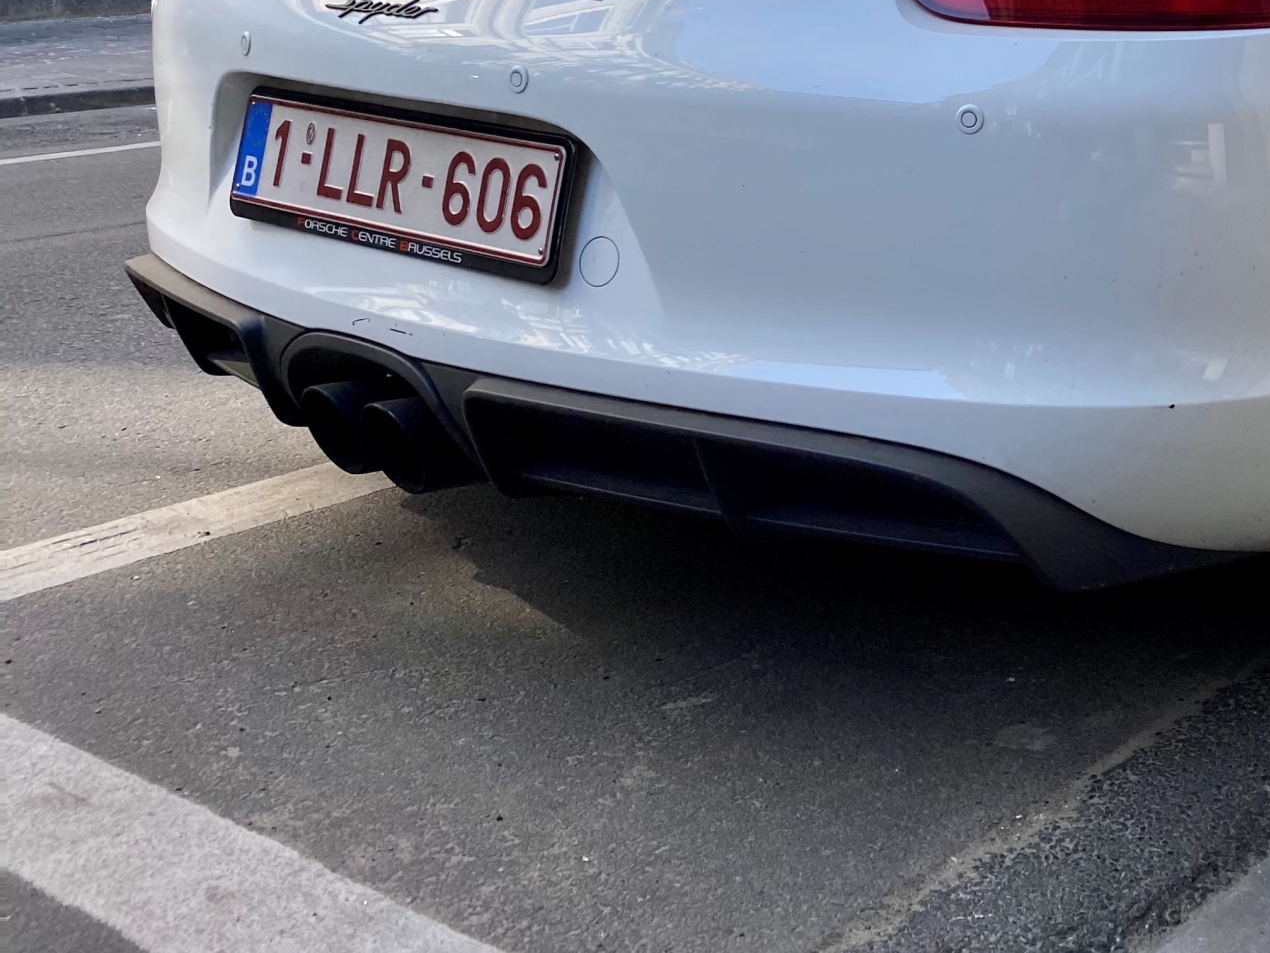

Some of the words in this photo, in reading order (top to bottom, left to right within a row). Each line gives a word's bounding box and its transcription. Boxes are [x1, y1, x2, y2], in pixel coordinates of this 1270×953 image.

[240, 155, 257, 187] B
[272, 119, 548, 241] 1-LLR-606
[296, 215, 348, 238] PORSCHE
[351, 229, 397, 249] CENTRE
[400, 239, 463, 264] BRUSSELS
